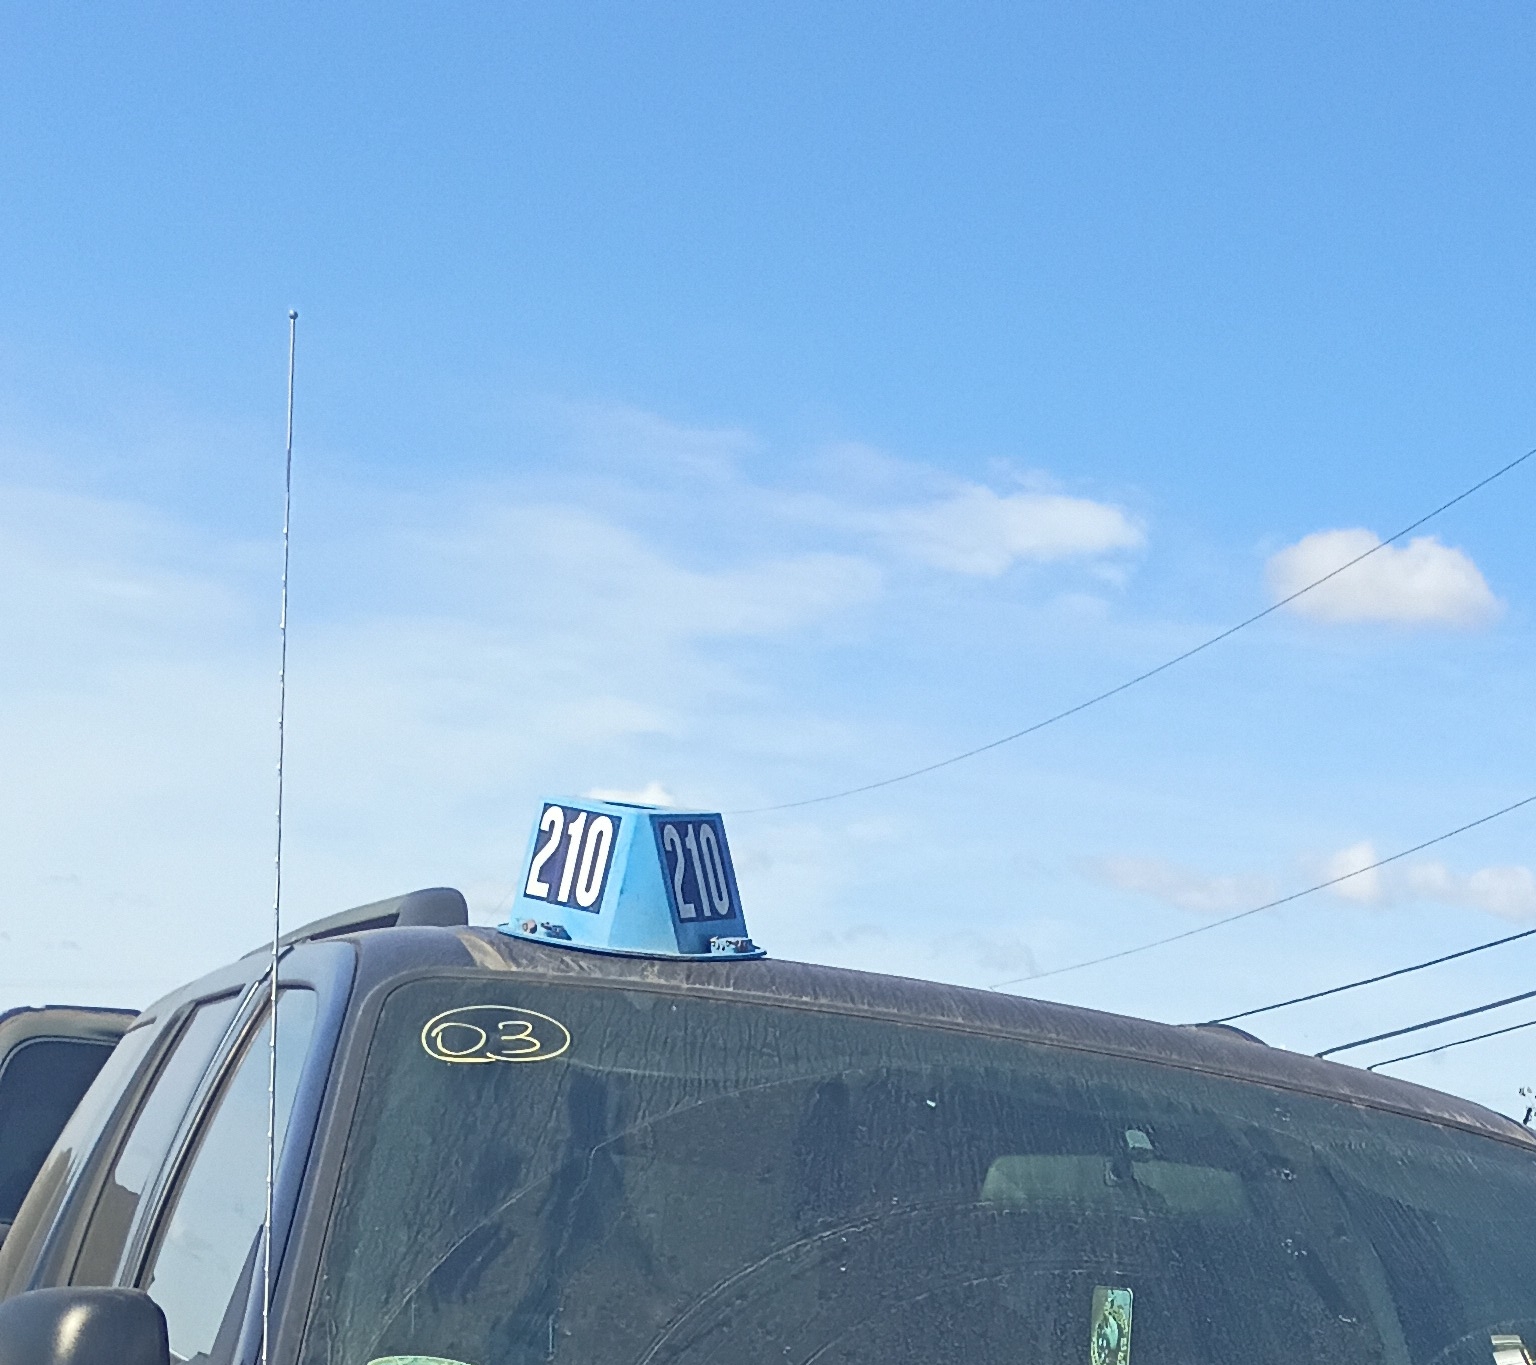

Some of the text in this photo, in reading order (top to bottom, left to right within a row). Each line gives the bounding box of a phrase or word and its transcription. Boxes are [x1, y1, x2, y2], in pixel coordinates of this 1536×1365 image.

[525, 805, 613, 908] 210
[663, 823, 731, 917] 210
[430, 1020, 542, 1056] 03
